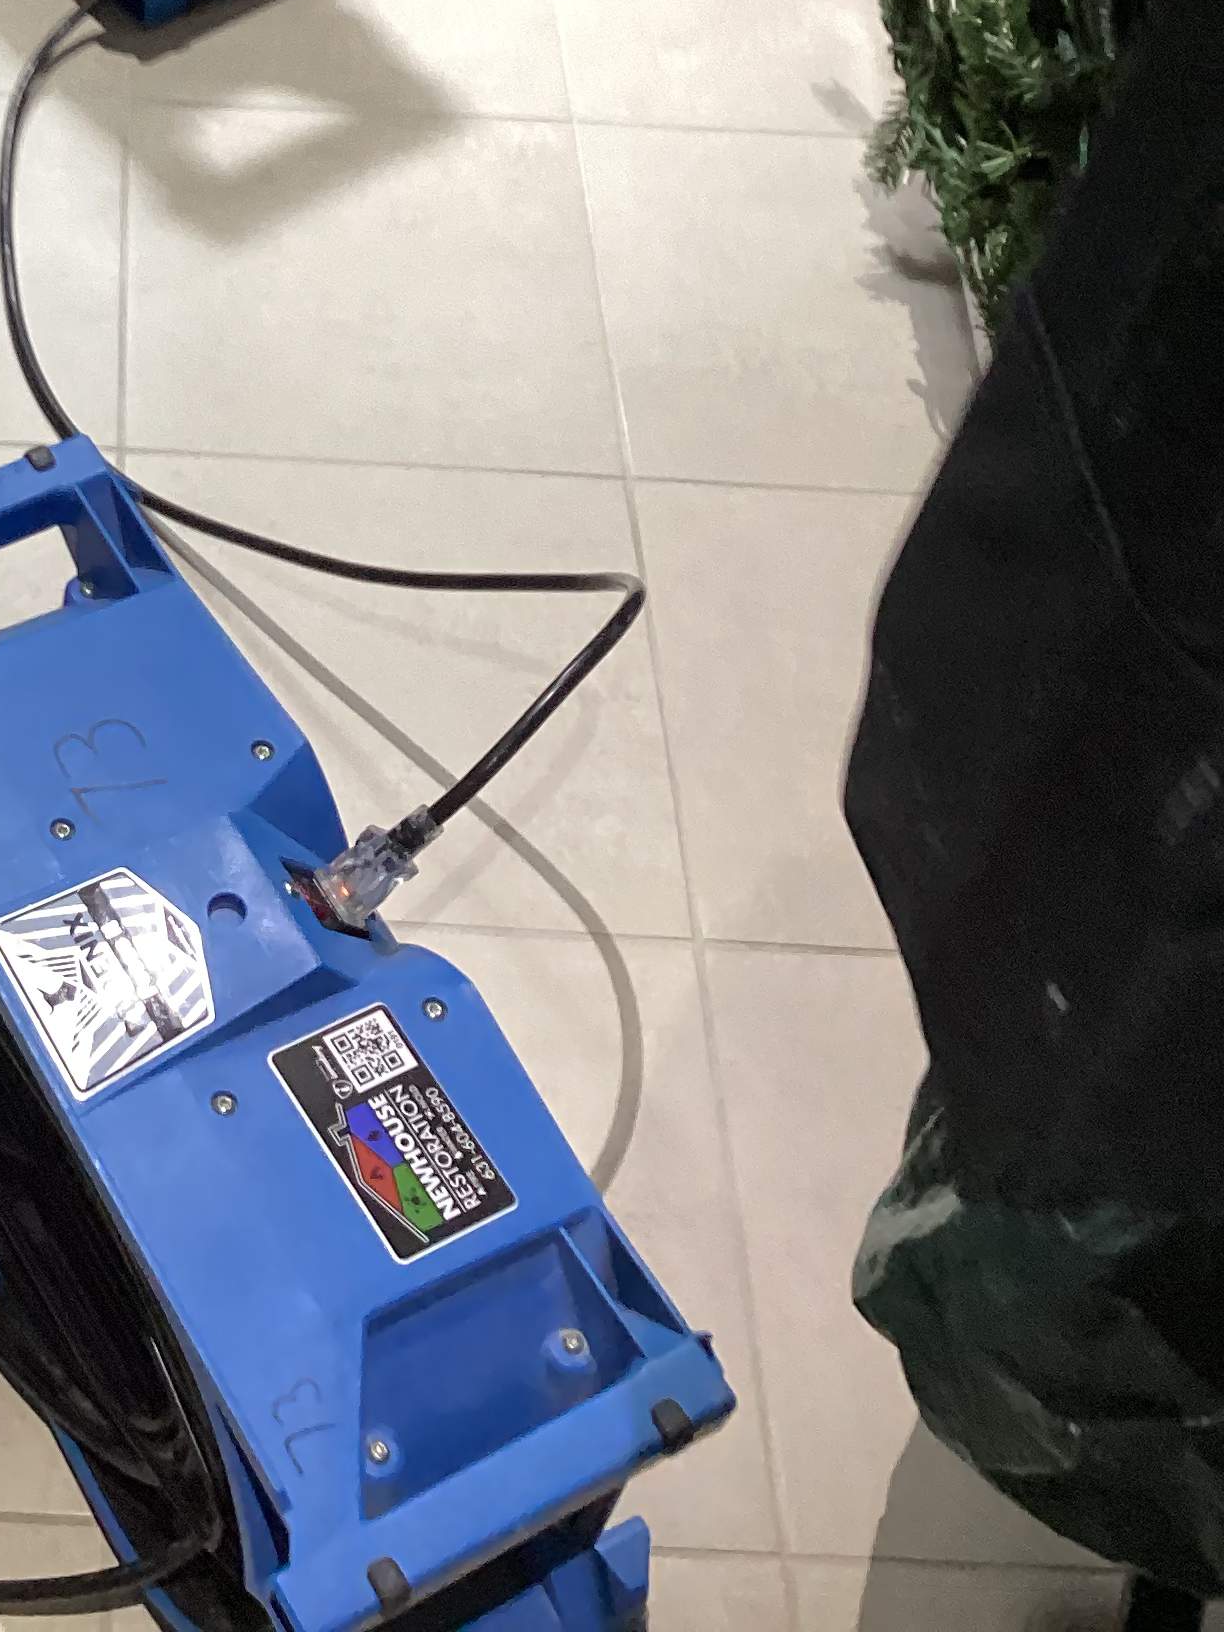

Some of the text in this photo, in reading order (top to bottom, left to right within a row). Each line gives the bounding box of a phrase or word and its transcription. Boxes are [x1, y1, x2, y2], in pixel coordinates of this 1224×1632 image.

[367, 1093, 462, 1220] NEWHOUSE
[388, 1084, 482, 1210] RESTORATION
[426, 1087, 496, 1180] 631-604-8590
